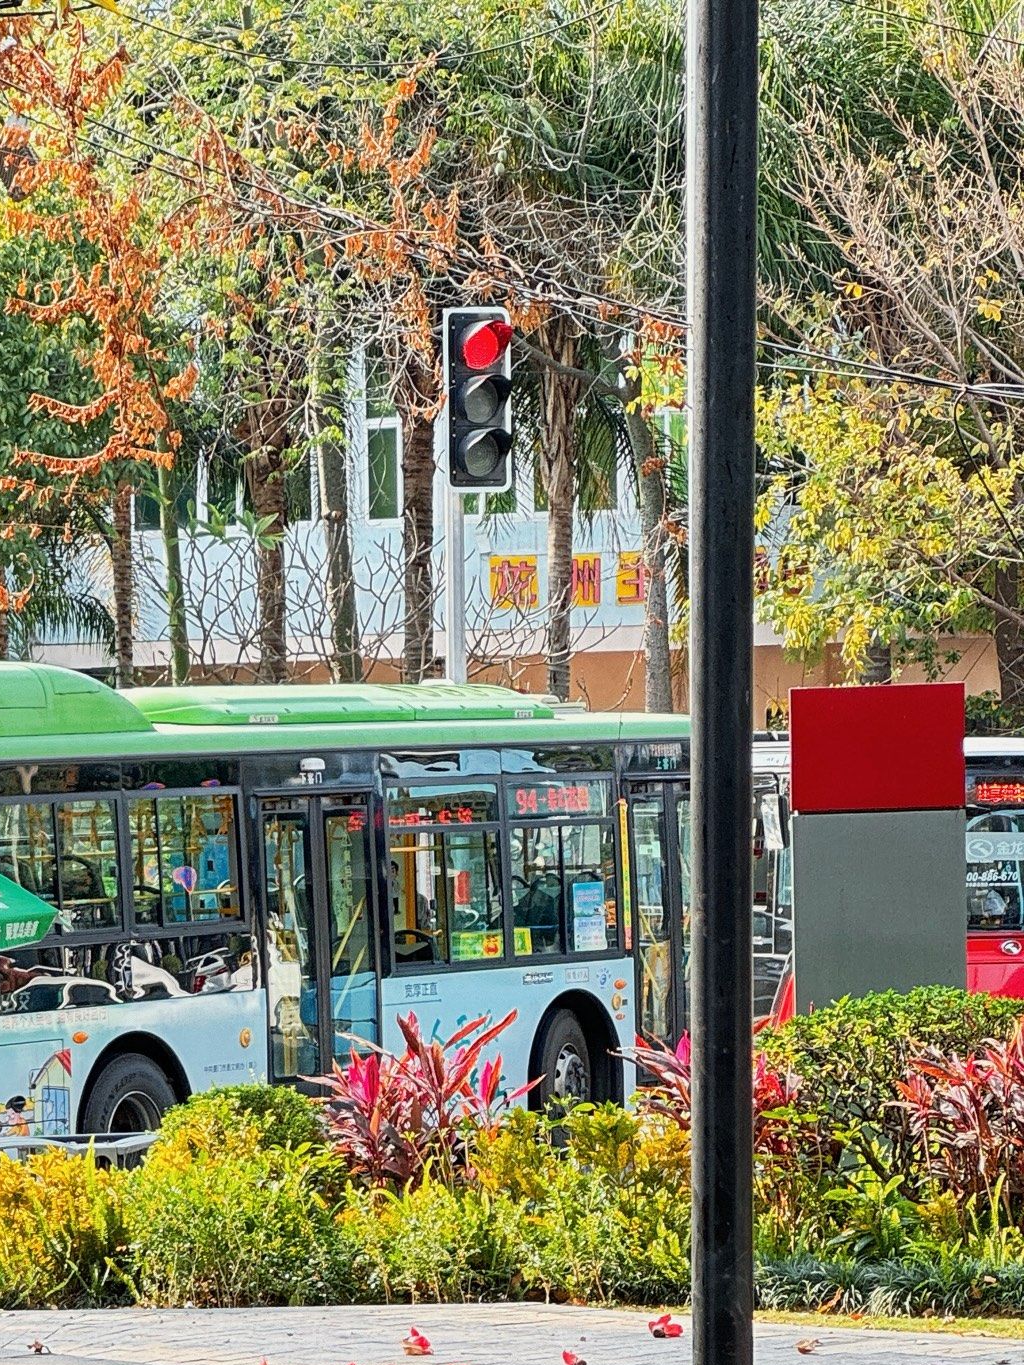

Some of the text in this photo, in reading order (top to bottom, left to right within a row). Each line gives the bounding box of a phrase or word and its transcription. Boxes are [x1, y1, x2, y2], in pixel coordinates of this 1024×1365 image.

[516, 788, 538, 814] 94
[405, 982, 438, 998] 宽厚正直
